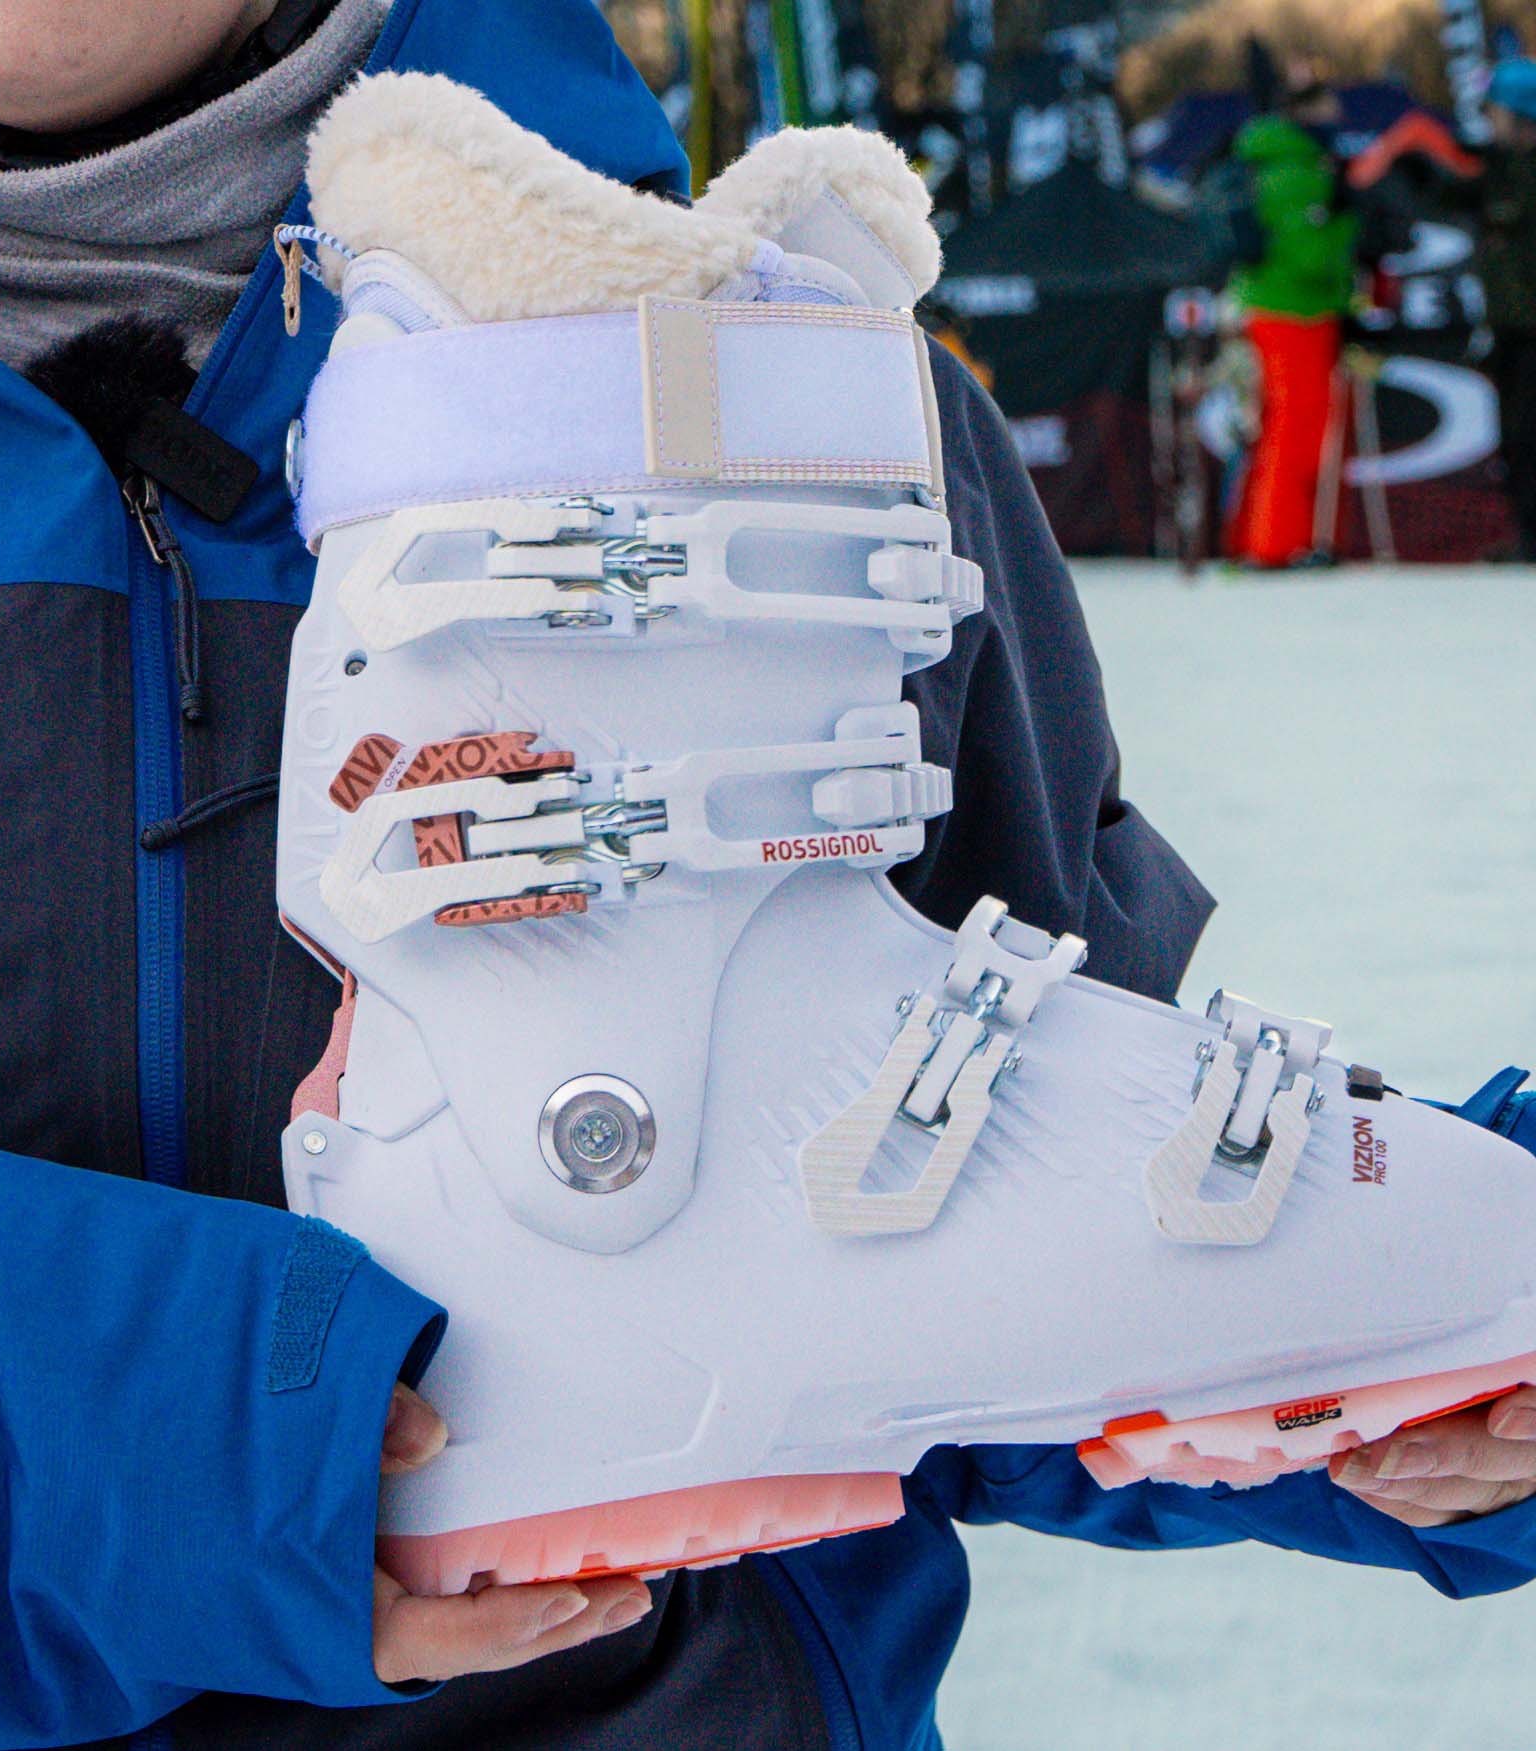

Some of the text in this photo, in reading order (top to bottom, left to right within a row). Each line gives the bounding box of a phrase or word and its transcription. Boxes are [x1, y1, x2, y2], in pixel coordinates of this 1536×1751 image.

[383, 758, 407, 789] OPEN
[761, 833, 884, 863] ROSSIGNOL
[1351, 1115, 1373, 1183] VIZION
[1373, 1139, 1387, 1186] PRO 100
[1273, 1397, 1339, 1421] GRIP
[1277, 1409, 1338, 1429] WALK
